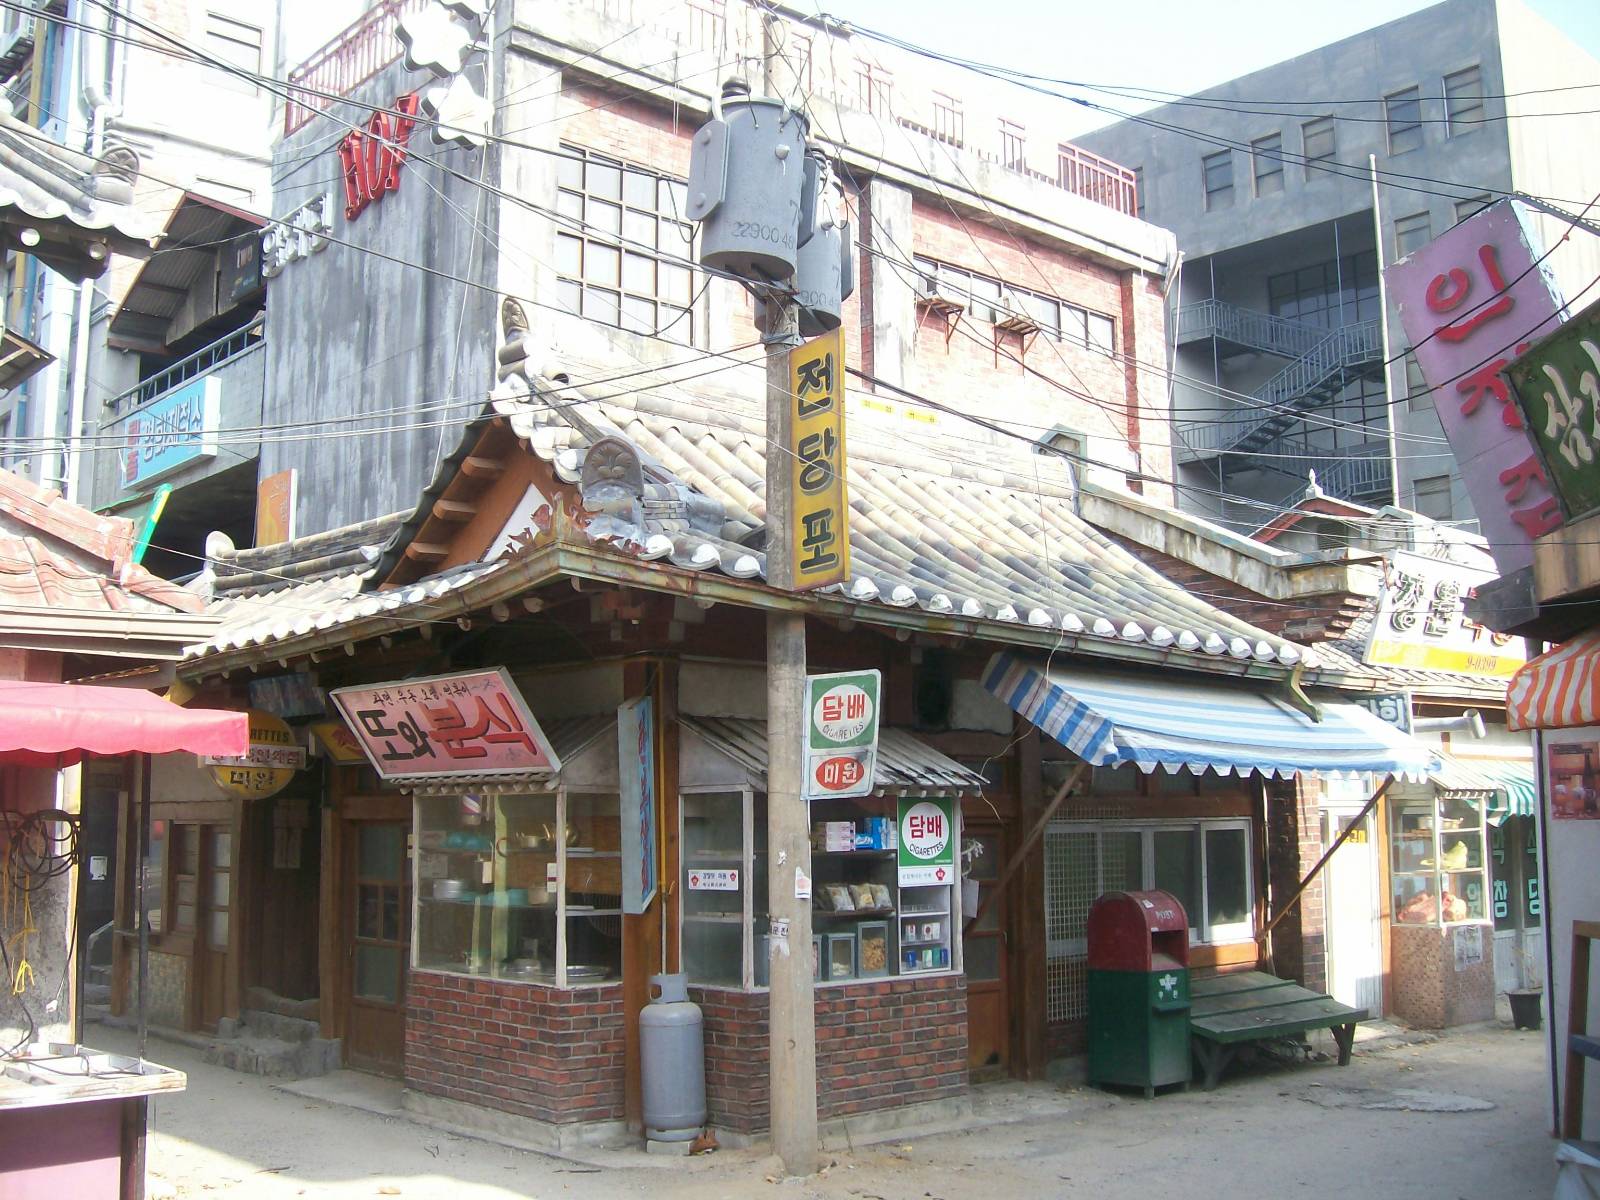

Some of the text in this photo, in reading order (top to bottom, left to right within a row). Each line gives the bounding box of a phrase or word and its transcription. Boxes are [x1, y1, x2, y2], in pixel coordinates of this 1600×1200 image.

[797, 353, 840, 574] 전당포
[823, 694, 866, 721] 담배
[824, 761, 857, 784] 미원
[909, 815, 943, 839] 담배
[909, 841, 944, 856] CIGARETTES
[1155, 909, 1175, 920] POST
